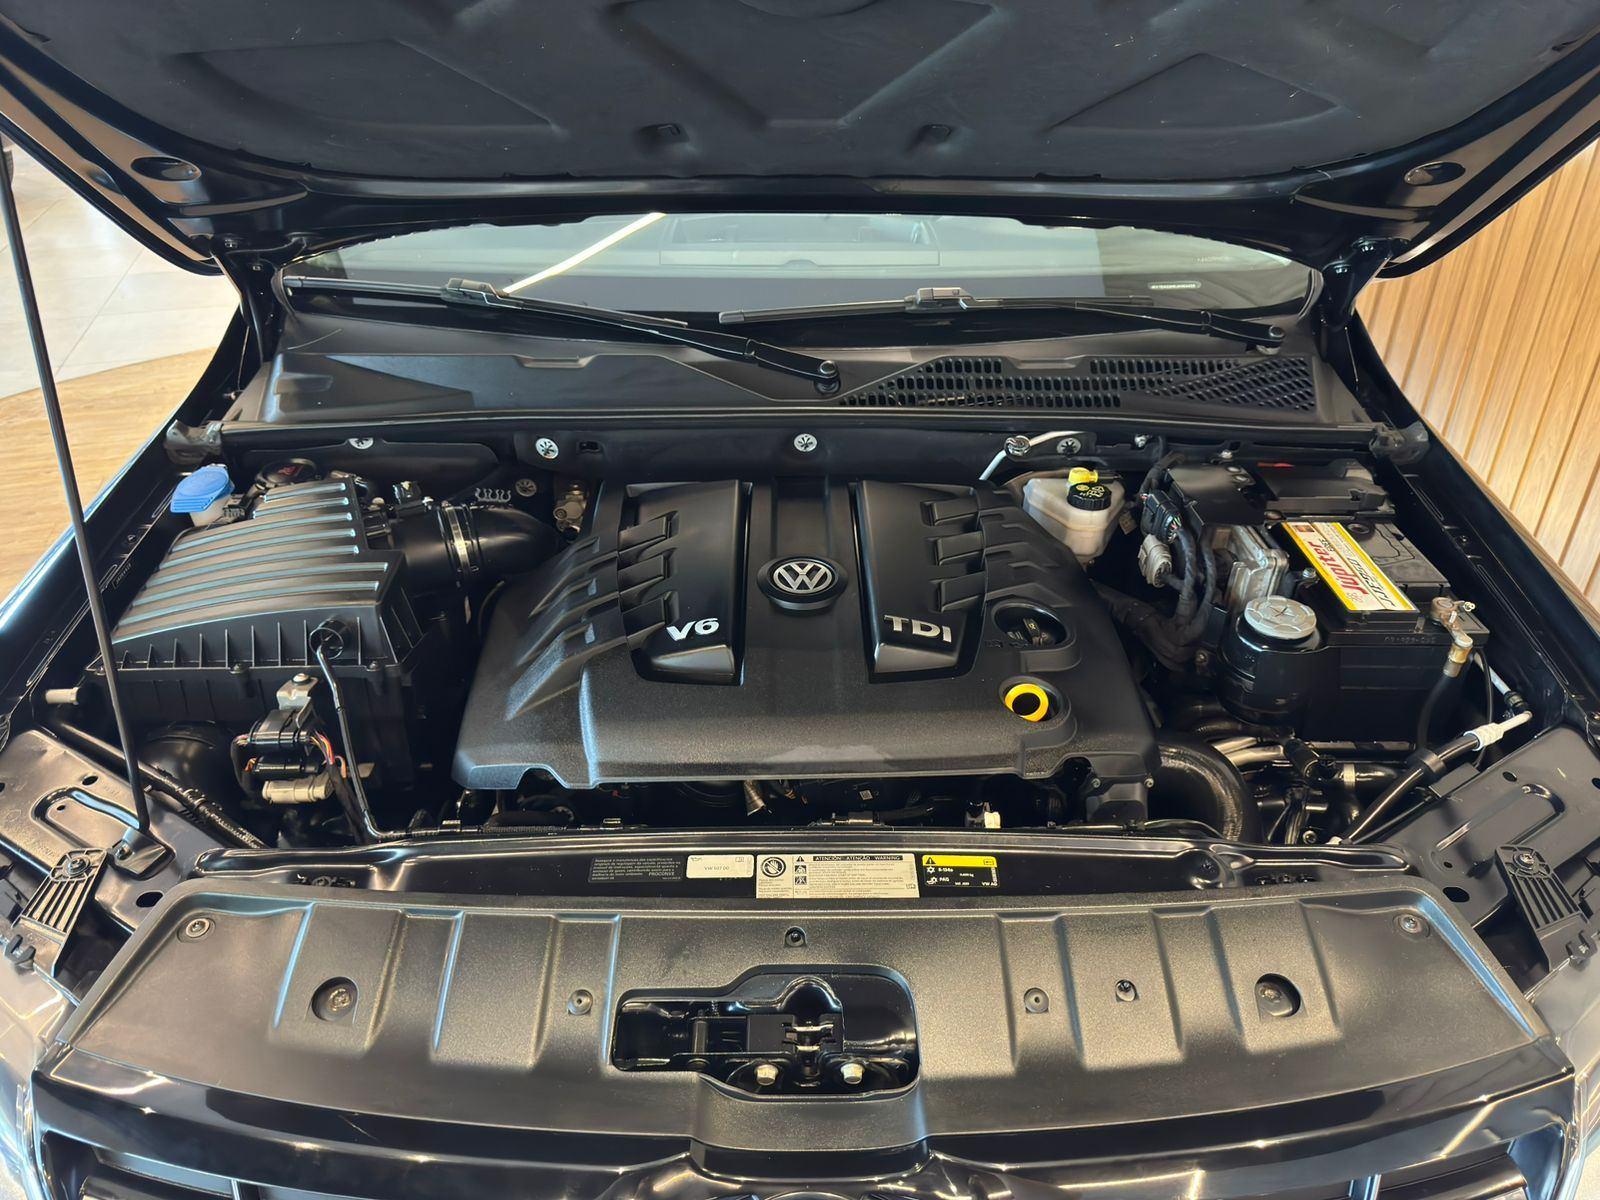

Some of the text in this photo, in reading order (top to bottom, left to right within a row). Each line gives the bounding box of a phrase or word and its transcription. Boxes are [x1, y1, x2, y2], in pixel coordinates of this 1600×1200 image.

[773, 561, 832, 594] VW
[1308, 541, 1369, 595] Júpiter
[666, 618, 719, 641] V6
[884, 615, 952, 642] TDI
